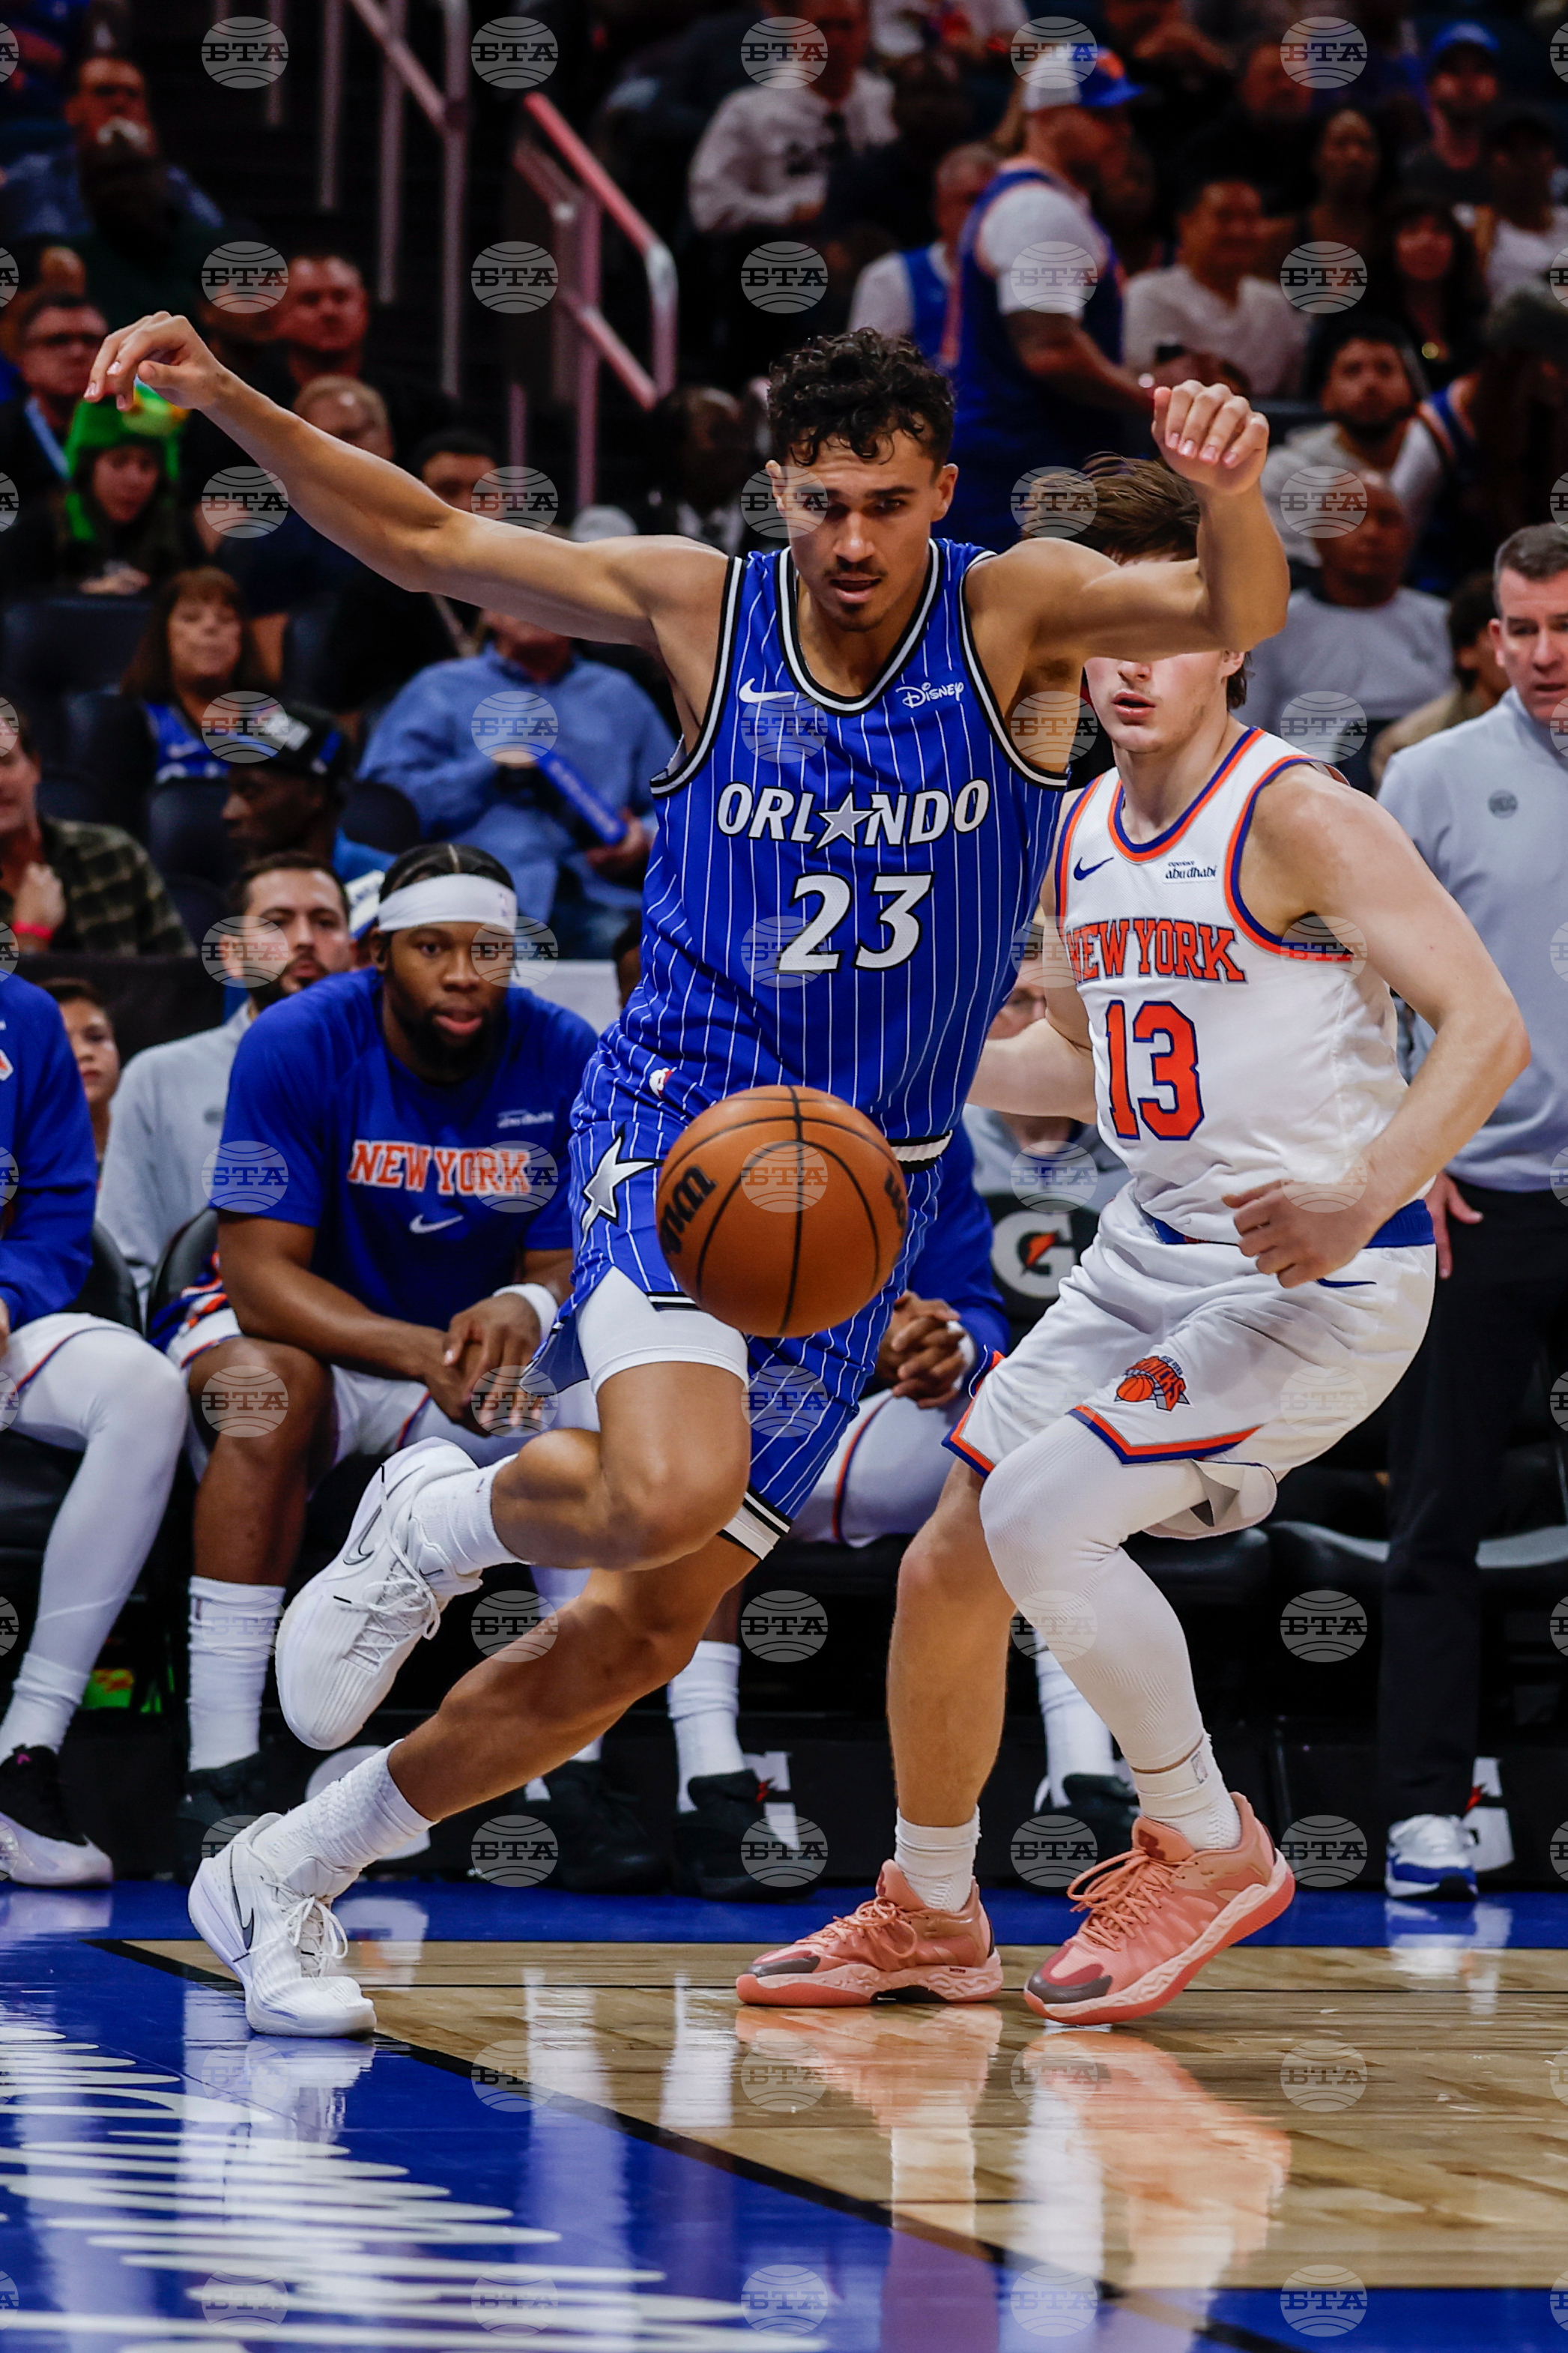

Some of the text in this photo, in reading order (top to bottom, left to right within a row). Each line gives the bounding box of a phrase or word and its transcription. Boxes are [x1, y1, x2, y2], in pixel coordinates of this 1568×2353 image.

[1165, 865, 1217, 879] abu dhabi
[777, 871, 935, 973] 23
[1066, 916, 1249, 987] NEW YORK
[1106, 1000, 1205, 1141] 13
[347, 1139, 532, 1197] NEW YORK
